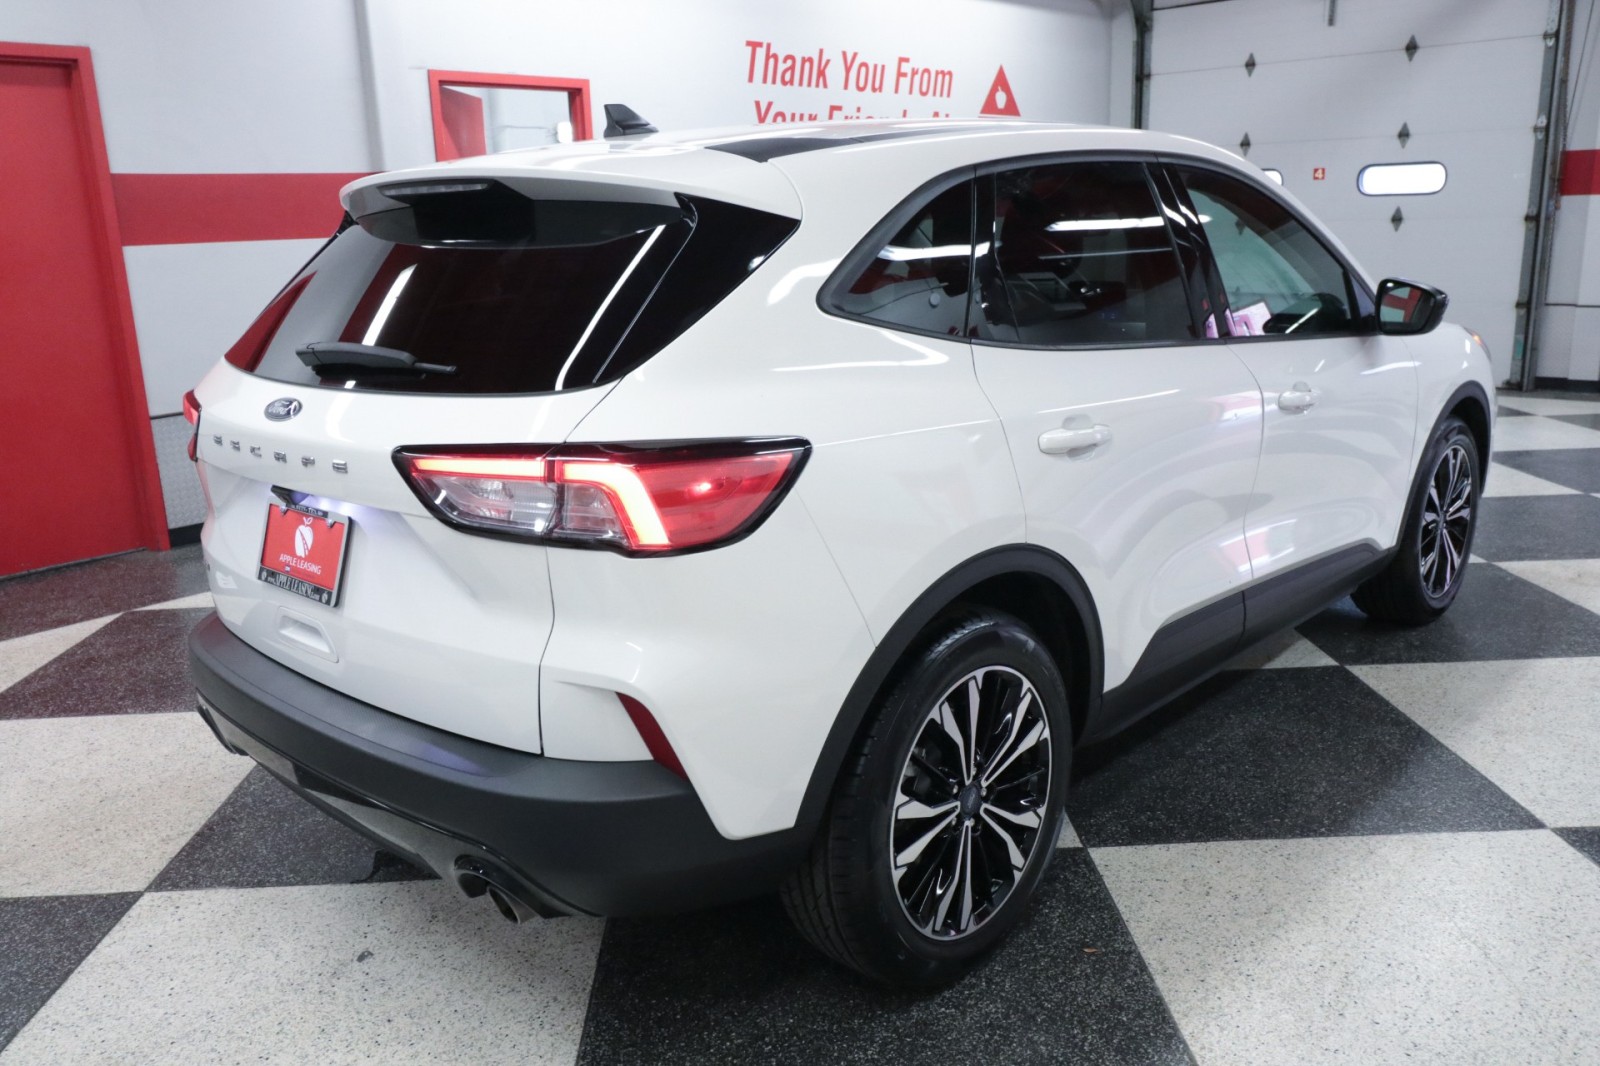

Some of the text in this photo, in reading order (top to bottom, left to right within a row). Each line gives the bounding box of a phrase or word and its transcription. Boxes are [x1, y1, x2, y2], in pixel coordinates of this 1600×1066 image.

[745, 40, 954, 99] Thank You From
[1314, 168, 1324, 180] 4
[267, 399, 301, 419] Ford
[279, 553, 297, 566] APPLE
[297, 559, 322, 575] LEASING
